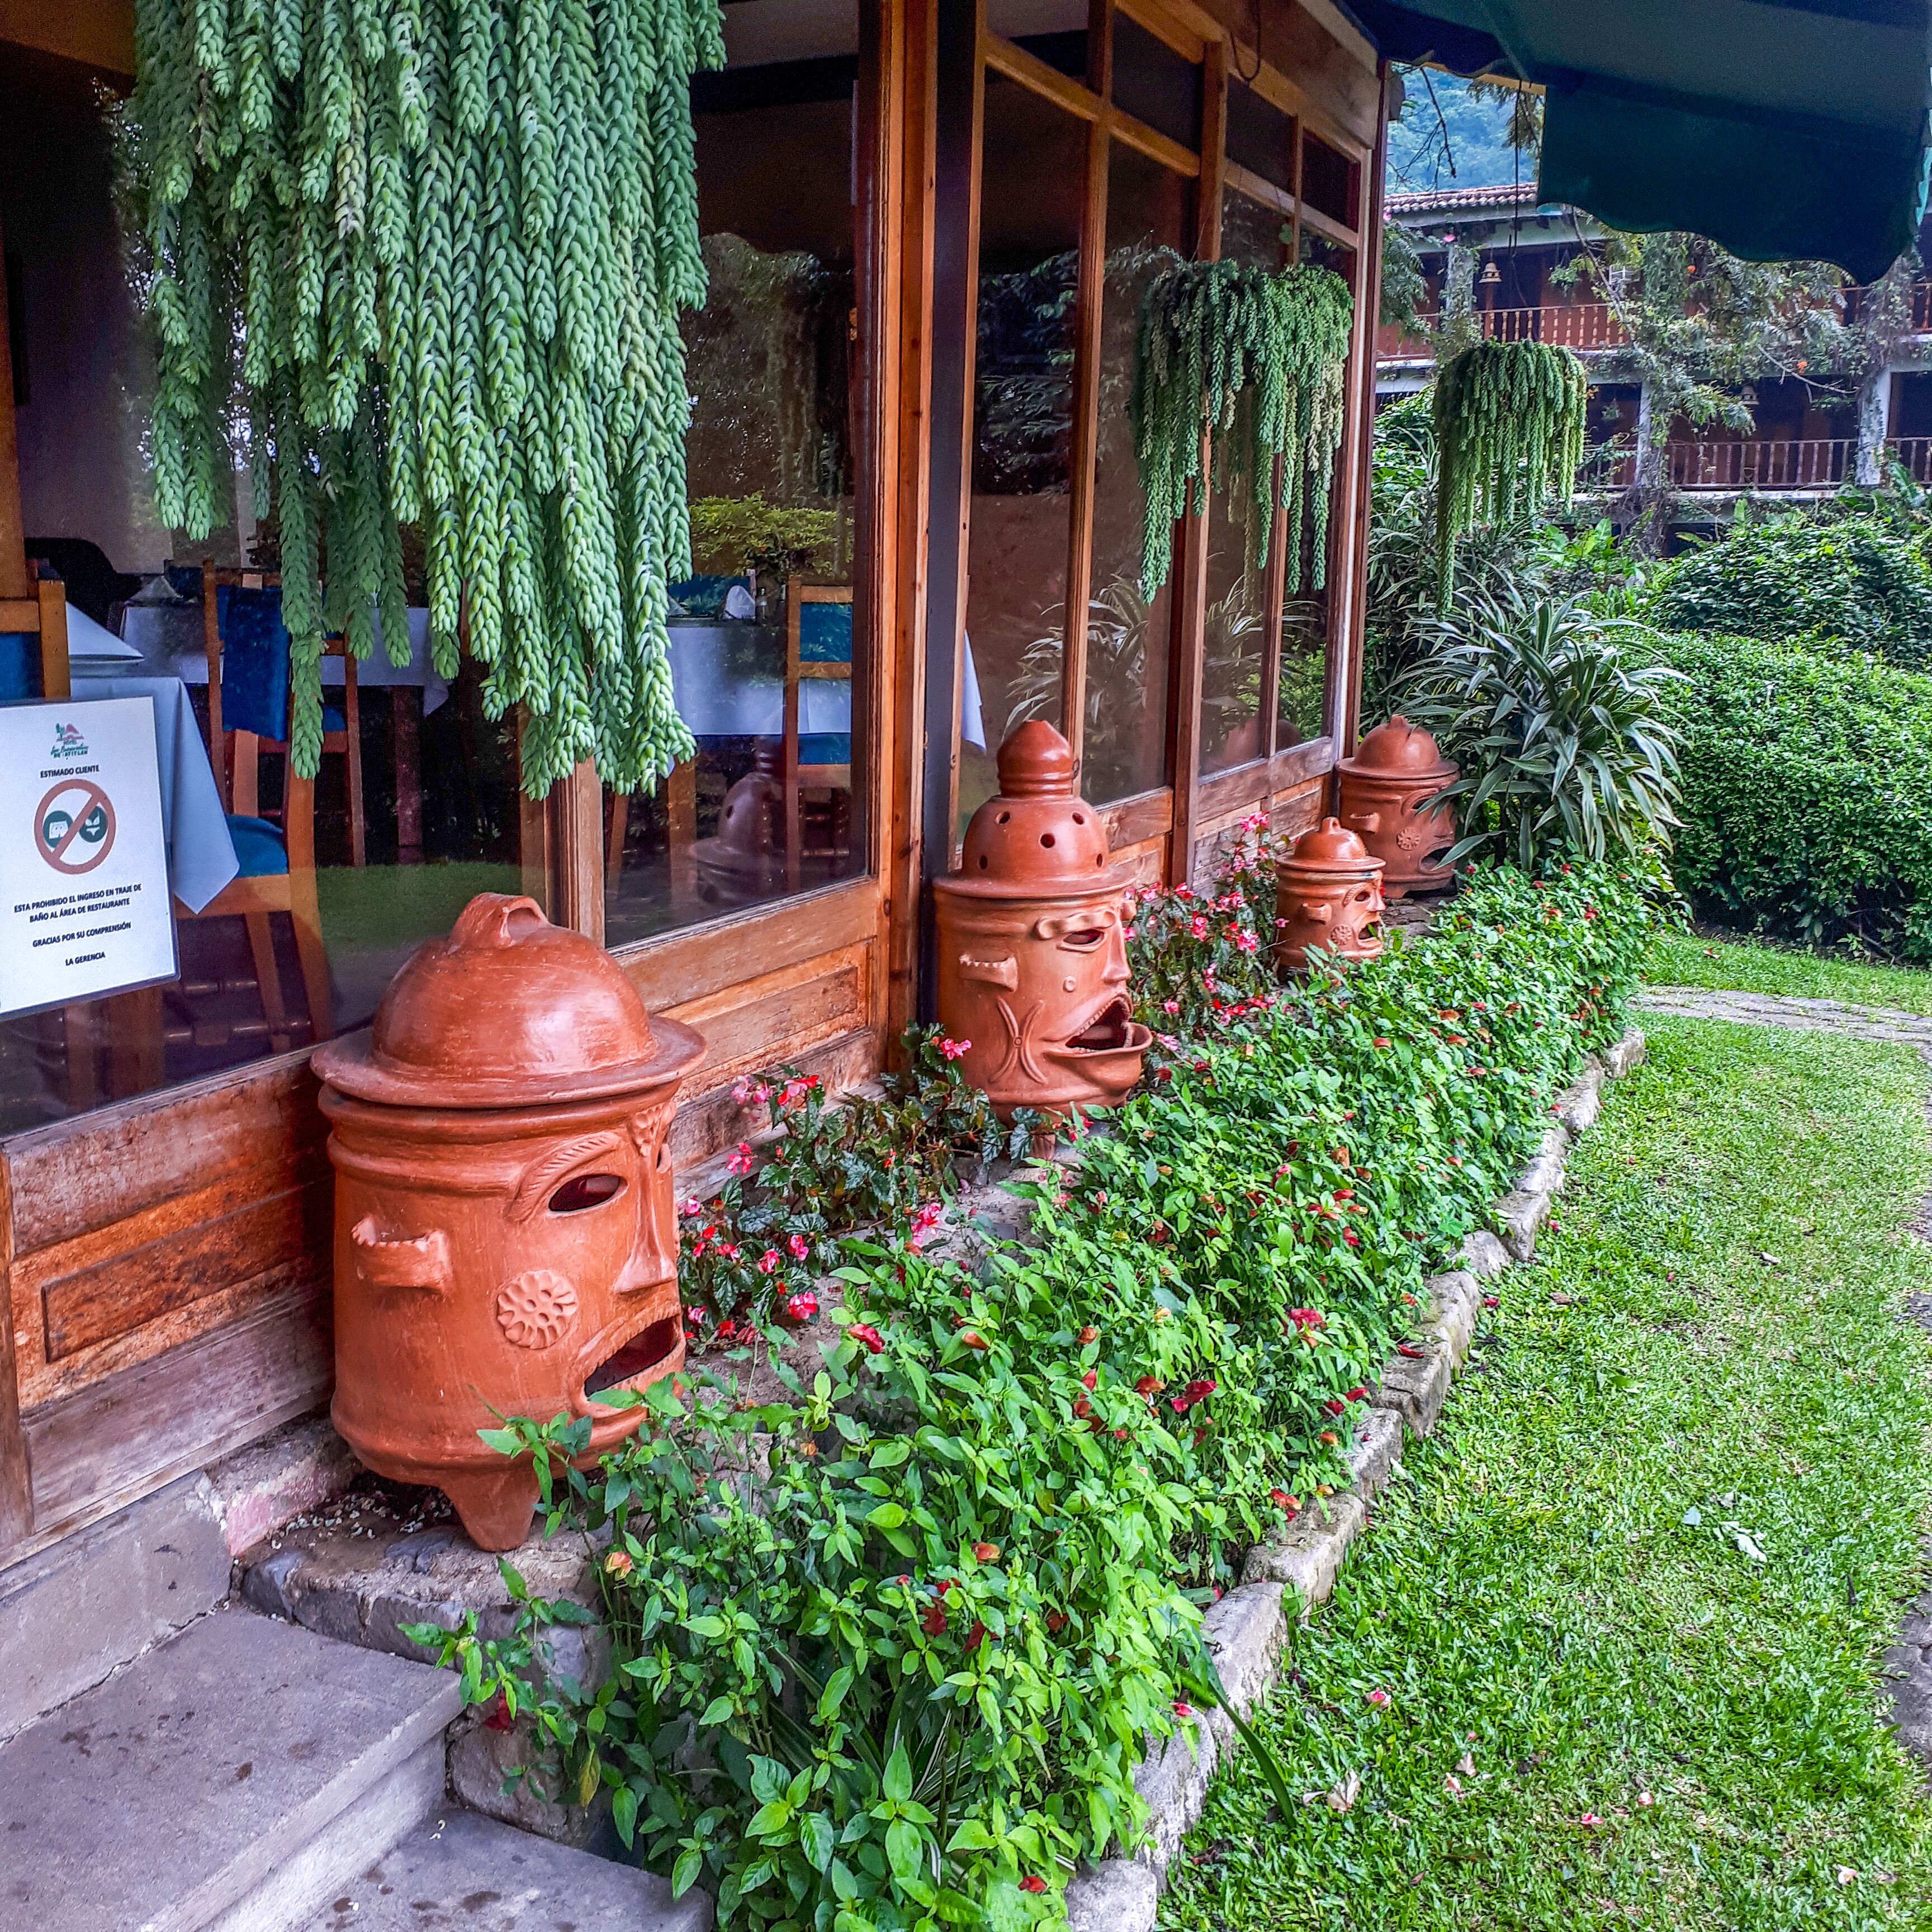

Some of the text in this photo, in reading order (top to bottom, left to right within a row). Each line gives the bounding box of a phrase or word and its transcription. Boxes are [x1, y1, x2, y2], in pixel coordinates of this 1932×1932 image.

[40, 764, 100, 778] ESTIMADO CLIENTE
[14, 903, 30, 913] ESTA
[32, 897, 68, 910] PROHIBIDO
[78, 890, 105, 901] INGRESO
[115, 885, 132, 895] TRAJE
[134, 883, 142, 892] DE
[30, 912, 49, 923] BAÑO
[50, 911, 58, 919] AL
[59, 908, 77, 917] ÁREA
[87, 898, 130, 912] RESTAURANTE
[32, 921, 131, 947] GRACIAS POR SU COMPRENSIÓN
[75, 951, 106, 964] GERENCIA
